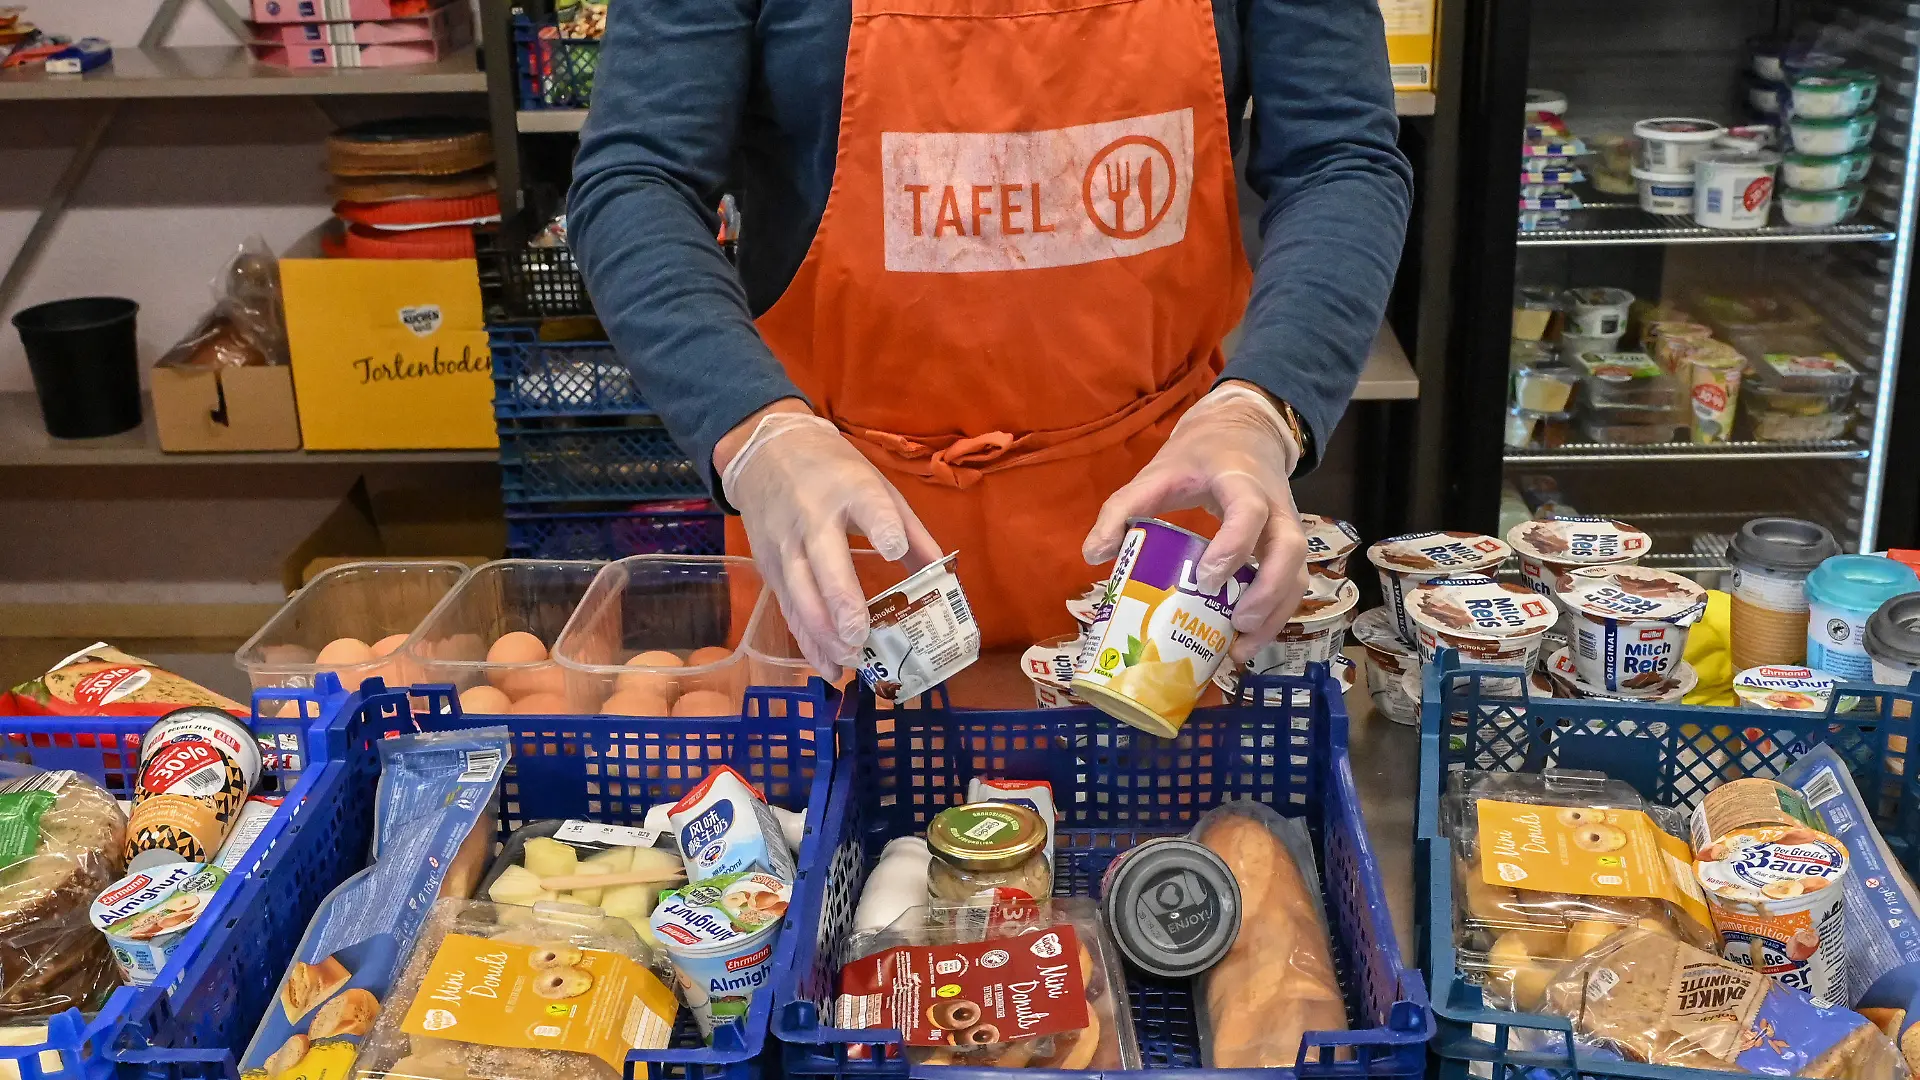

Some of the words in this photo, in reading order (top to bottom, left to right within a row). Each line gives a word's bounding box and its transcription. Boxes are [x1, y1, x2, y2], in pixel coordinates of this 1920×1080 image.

[904, 183, 1056, 237] TAFEL
[1421, 546, 1463, 566] Reis
[1444, 542, 1484, 562] Milch
[1571, 533, 1598, 556] Reis
[1600, 533, 1618, 557] Milch
[1521, 574, 1551, 596] Milch
[1598, 587, 1662, 612] Reis
[1206, 598, 1221, 611] AUS
[1465, 598, 1502, 629] Reis
[1494, 597, 1525, 627] Milch
[1583, 593, 1646, 615] Milch
[1171, 607, 1227, 652] MANGO
[1170, 629, 1214, 664] LUGHURT
[1606, 631, 1615, 681] ORIGINAL
[1625, 642, 1671, 656] Milch
[1053, 654, 1070, 682] Milch
[1094, 667, 1114, 679] VEGAN
[1624, 656, 1668, 674] Reis
[1760, 668, 1808, 678] Ehrmann
[152, 746, 208, 786] -30%
[687, 818, 729, 857] 酸牛奶
[688, 809, 721, 838] 风味
[1520, 812, 1550, 854] Donuts
[1493, 828, 1523, 862] Mini
[1774, 845, 1790, 857] Der
[1790, 847, 1828, 862] Große
[1742, 846, 1840, 878] Bauer
[100, 867, 188, 924] Almighurt
[102, 876, 147, 905] Ehrmann
[664, 903, 738, 942] Almighurt
[1167, 909, 1211, 935] ENJOY!
[726, 946, 770, 971] Ehrmann
[1742, 952, 1784, 966] Gße
[430, 970, 466, 1008] Mini
[466, 951, 508, 999] Donuts
[710, 962, 774, 993] Almigh
[1036, 963, 1069, 1000] Mini
[1679, 976, 1751, 993] SCHNITTE
[1008, 980, 1050, 1030] Donuts
[1678, 985, 1747, 1010] DINKEL
